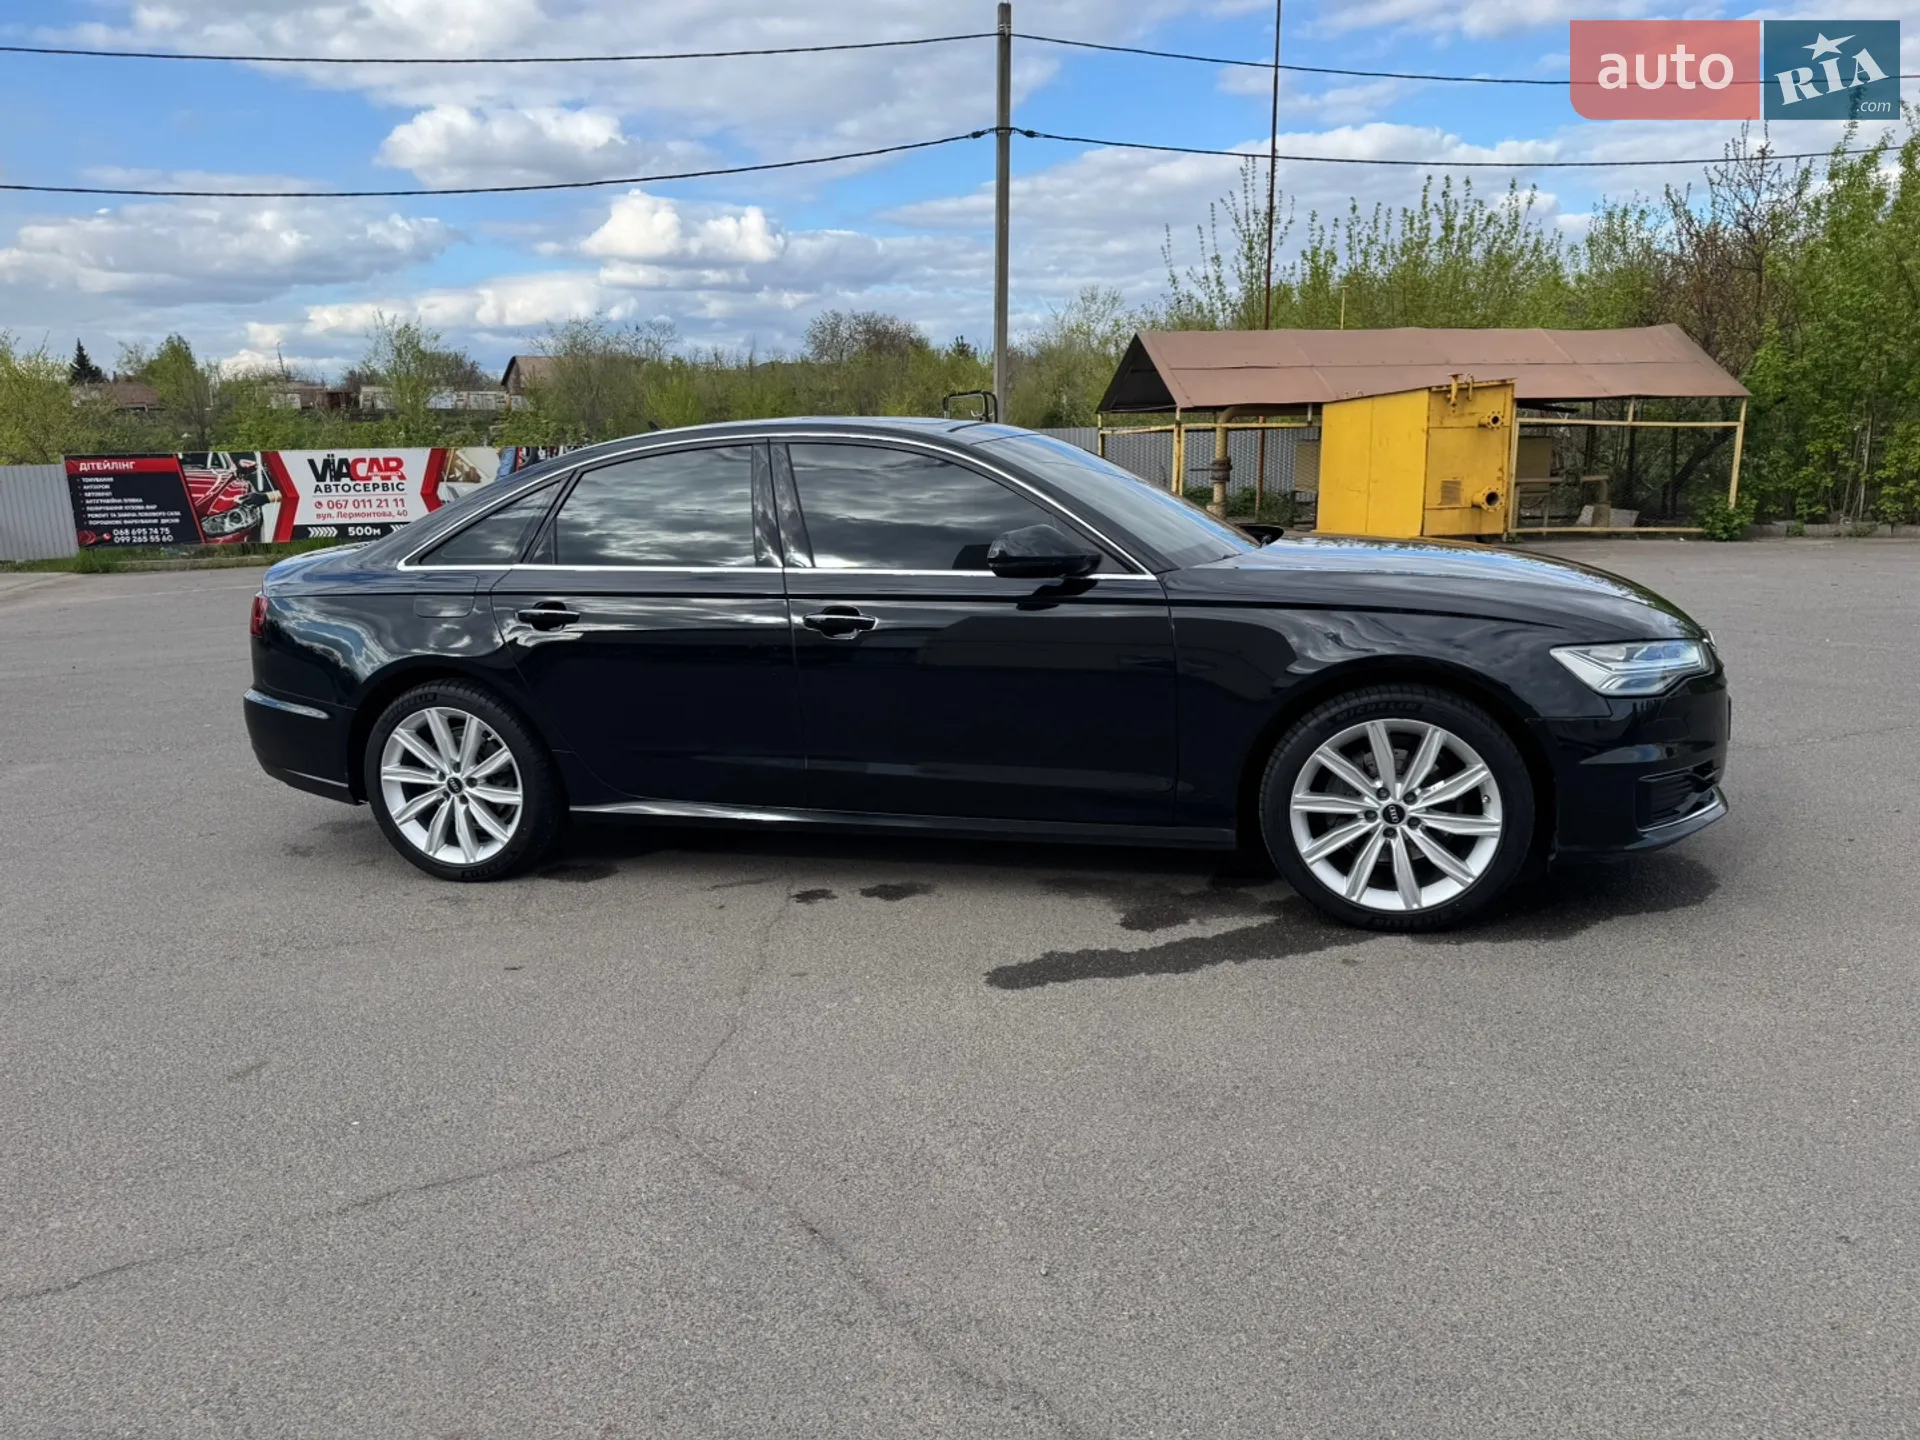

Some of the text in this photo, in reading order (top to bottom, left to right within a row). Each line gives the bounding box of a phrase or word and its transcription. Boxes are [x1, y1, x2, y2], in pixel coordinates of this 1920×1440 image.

[79, 460, 136, 472] ДІТЕЙЛІНГ
[313, 482, 406, 494] АВТОСЕРВІС
[326, 498, 405, 510] 067 011 21 11
[316, 512, 335, 521] вул.
[396, 509, 408, 517] 40
[113, 536, 131, 544] 099
[149, 535, 160, 543] 55
[161, 534, 174, 542] 60
